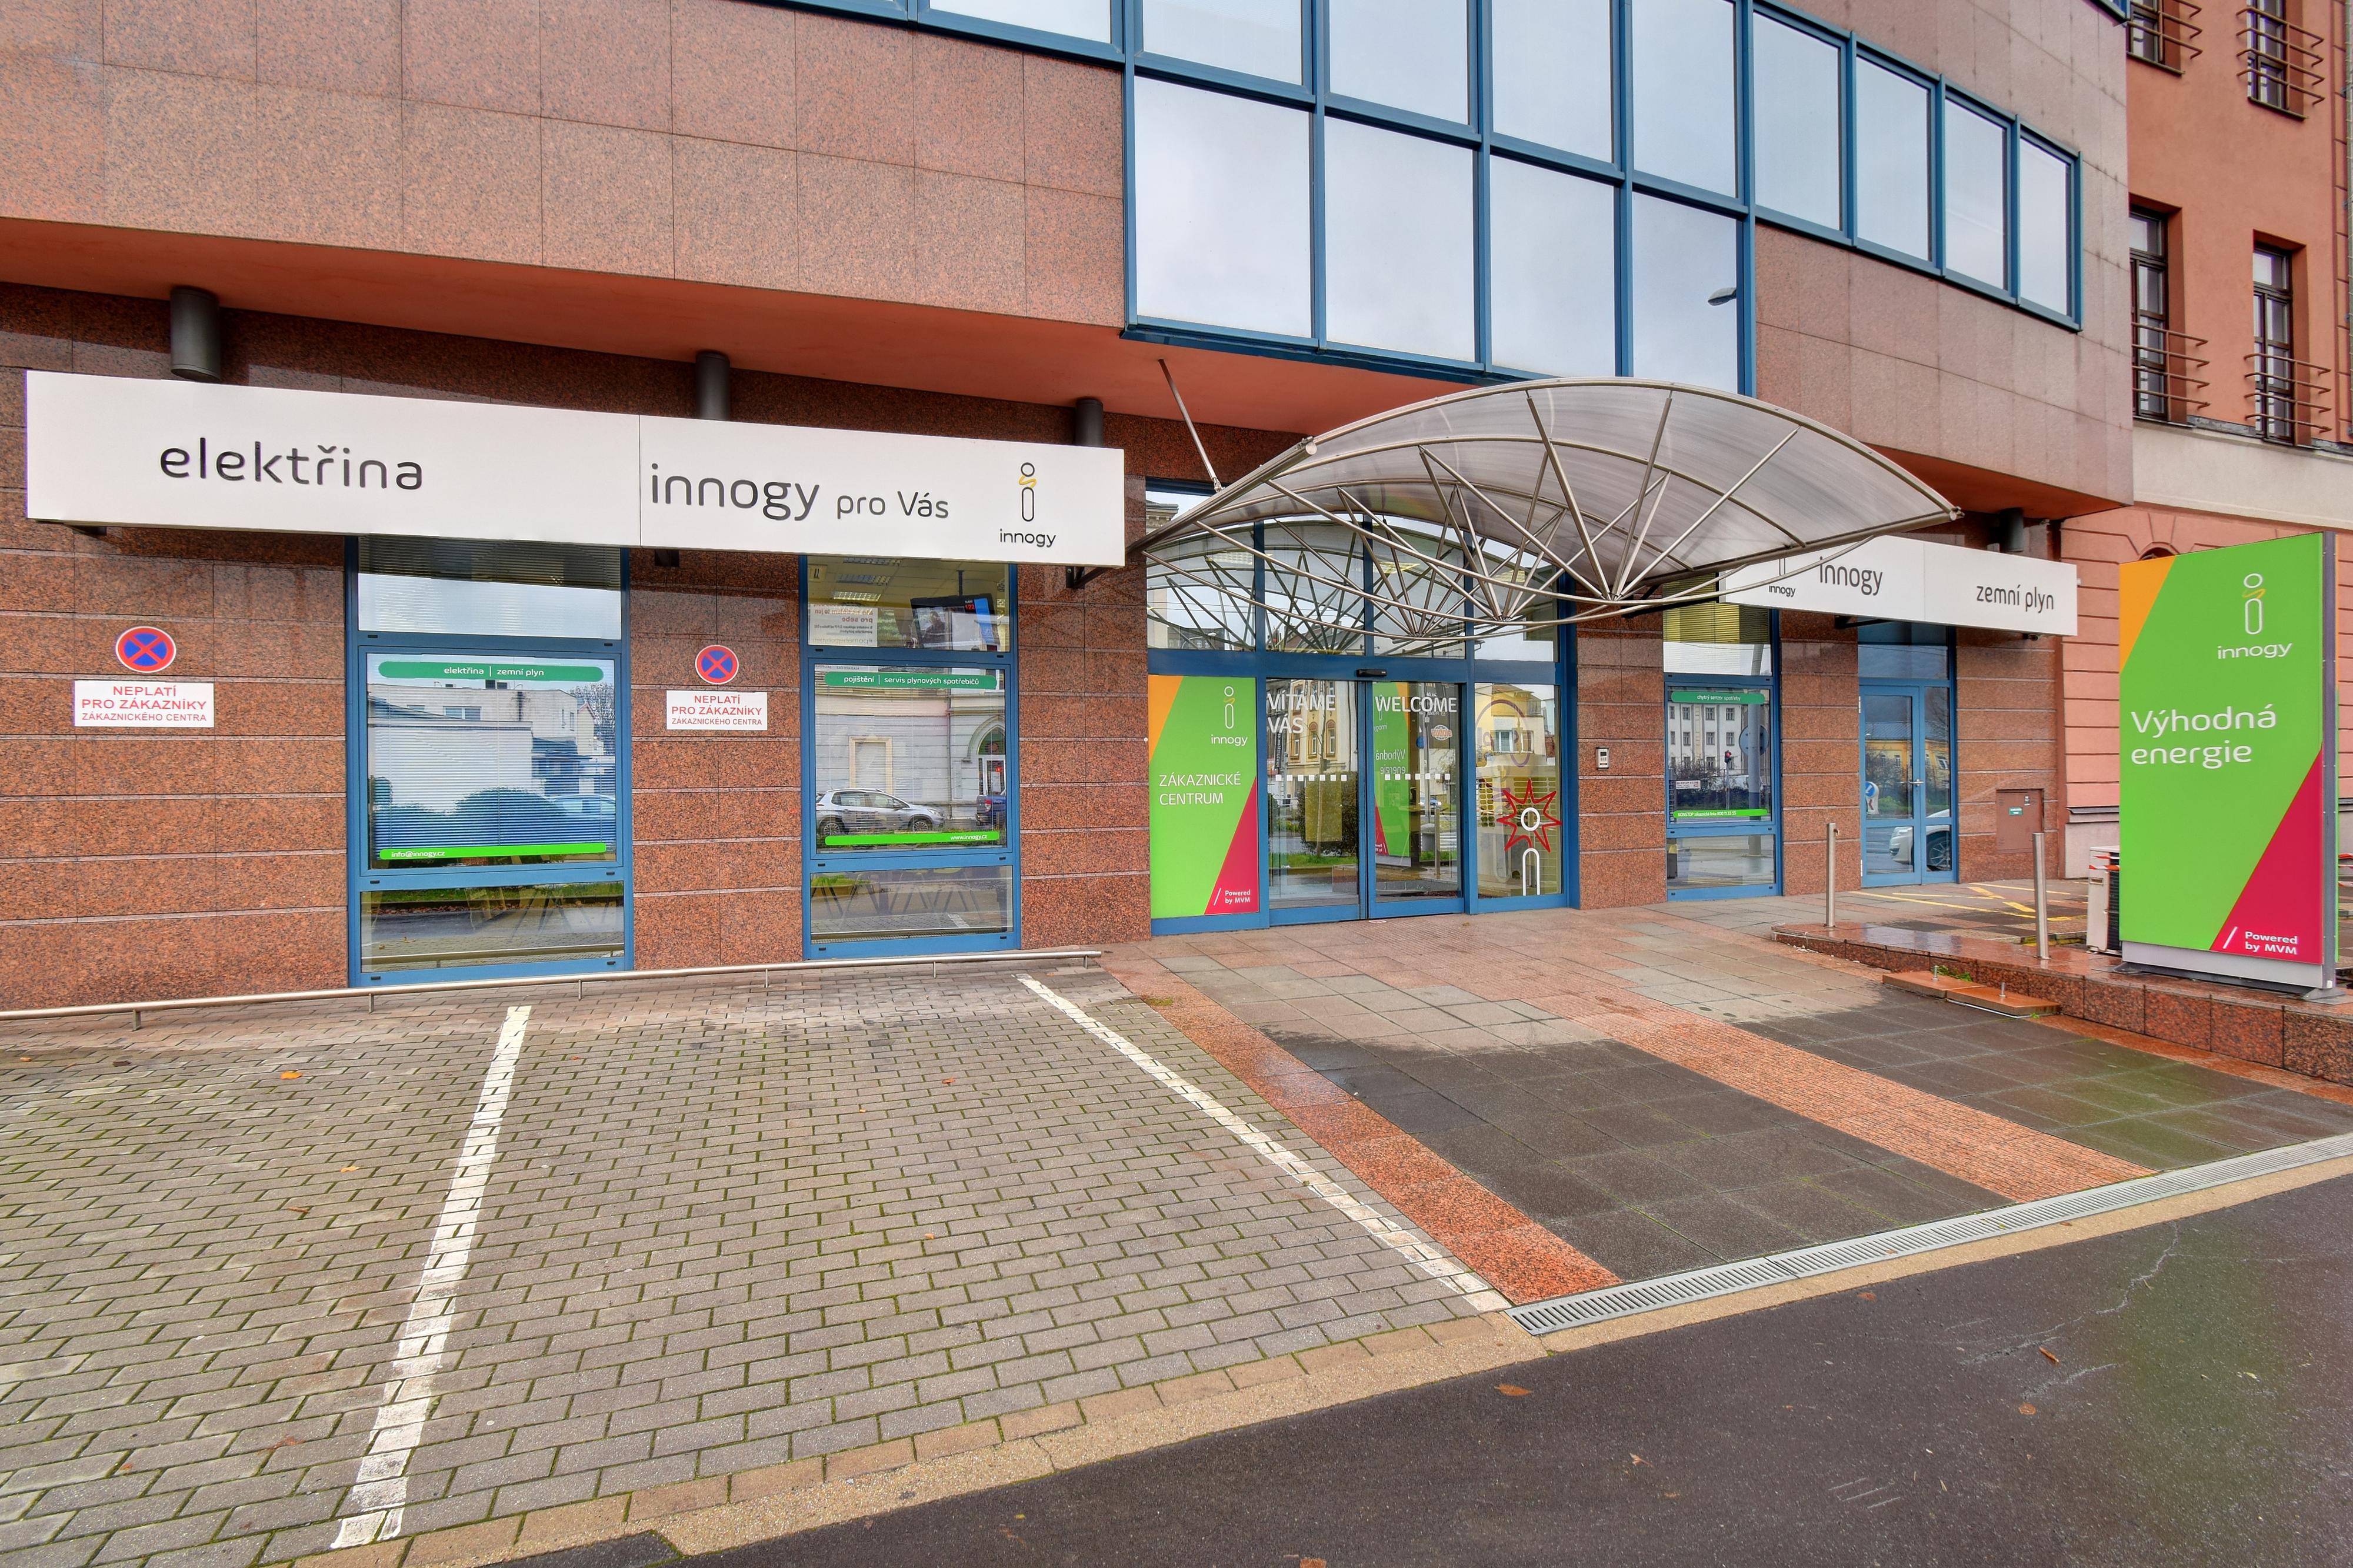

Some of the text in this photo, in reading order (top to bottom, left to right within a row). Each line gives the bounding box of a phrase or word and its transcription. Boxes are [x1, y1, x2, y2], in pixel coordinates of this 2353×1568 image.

[160, 436, 422, 490] elektřina
[651, 463, 949, 521] innogy pro Vás
[999, 529, 1056, 548] innogy
[1819, 556, 1883, 595] innogy
[1769, 585, 1796, 598] innogy
[1977, 585, 2054, 613] zemní plyn
[2217, 643, 2292, 659] innogy
[444, 666, 484, 675] elektřina
[525, 668, 544, 677] plyn
[113, 685, 176, 696] NEPLATÍ
[82, 698, 206, 710] PRO ZÁKAZNÍKY
[694, 695, 741, 704] NEPLATÍ
[1267, 689, 1336, 711] VÍTÁME
[1375, 696, 1457, 713] WELCOME
[82, 711, 162, 721] ZÁKAZNICKÉHO
[672, 705, 762, 715] PRO ZÁKAZNÍKY
[1267, 713, 1304, 734] VÁS
[2131, 704, 2277, 738] Výhodná
[1211, 734, 1248, 746] innogy
[2131, 740, 2252, 769] energie
[1159, 772, 1241, 786] ZÁKAZNICKÉ
[1159, 792, 1224, 805] CENTRUM
[2245, 931, 2298, 945] Powered
[2245, 942, 2297, 955] by MVM
